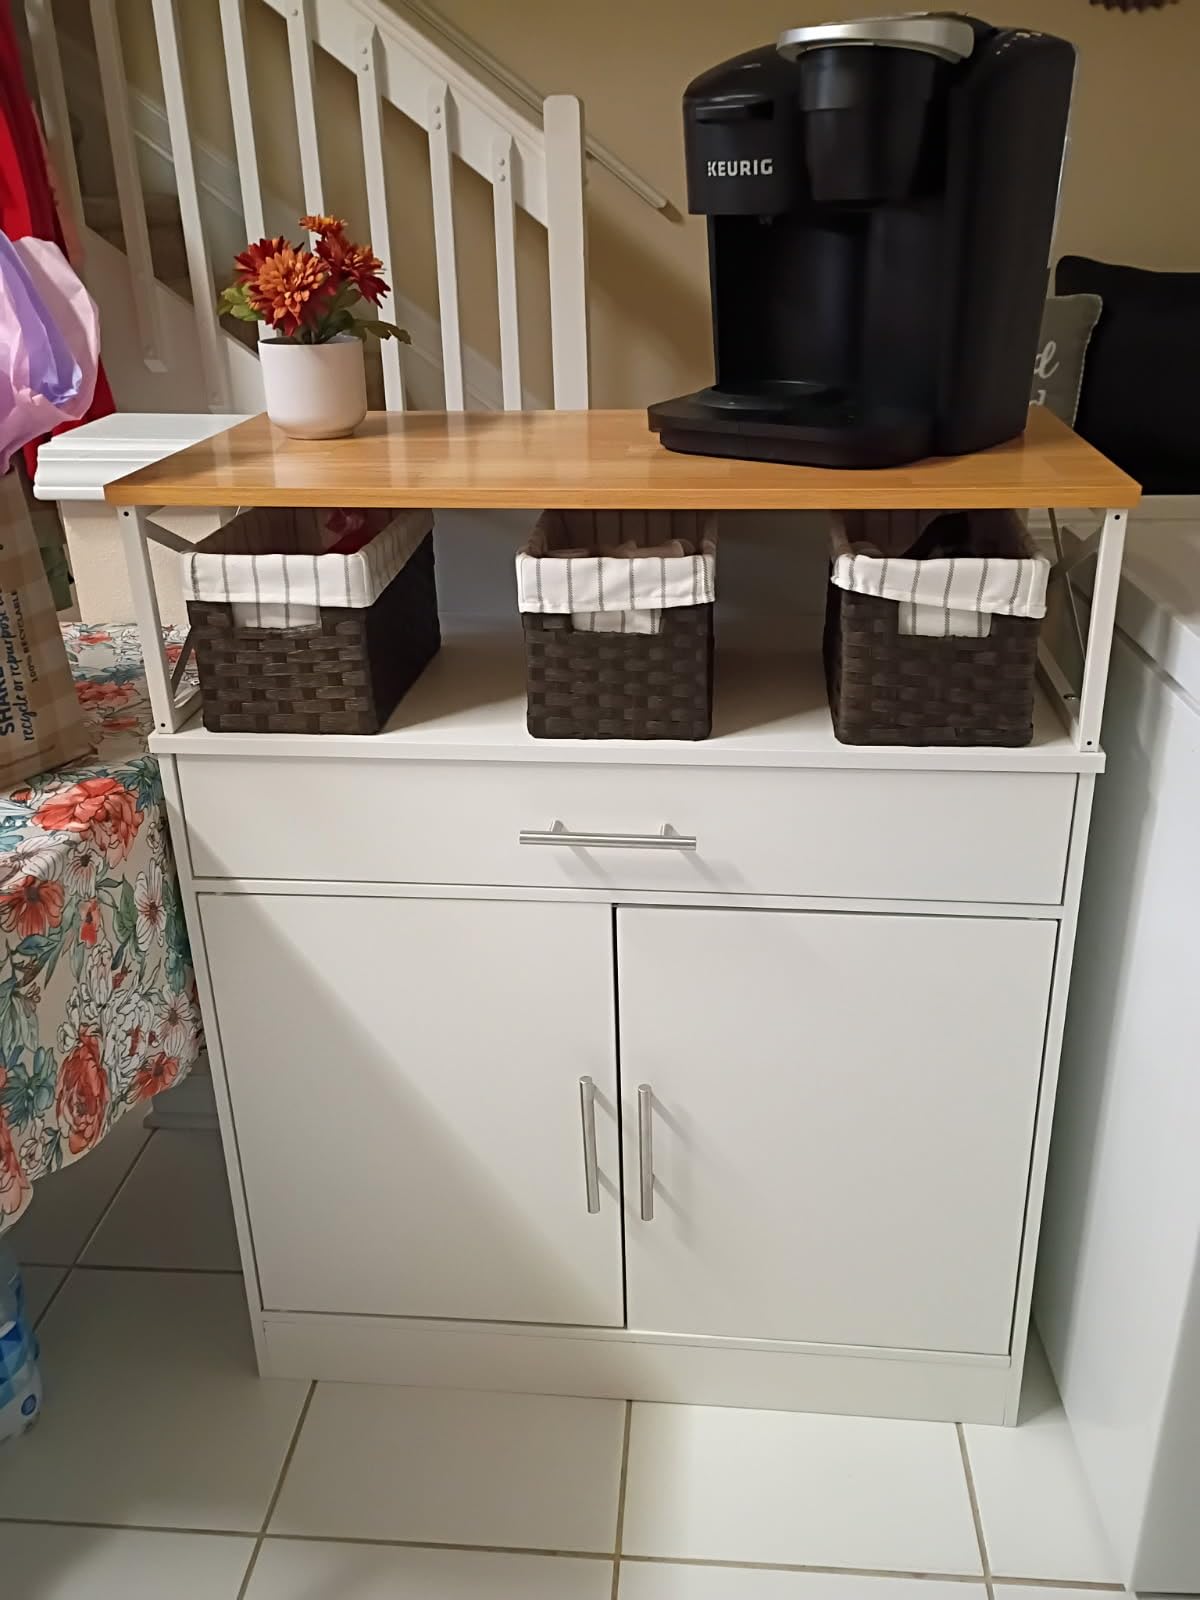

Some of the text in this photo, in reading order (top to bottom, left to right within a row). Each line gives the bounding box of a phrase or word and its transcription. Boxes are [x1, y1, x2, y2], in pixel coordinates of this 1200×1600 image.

[707, 158, 774, 177] KEURIG
[0, 667, 15, 736] SHA
[14, 680, 24, 692] or
[12, 695, 37, 741] recycle
